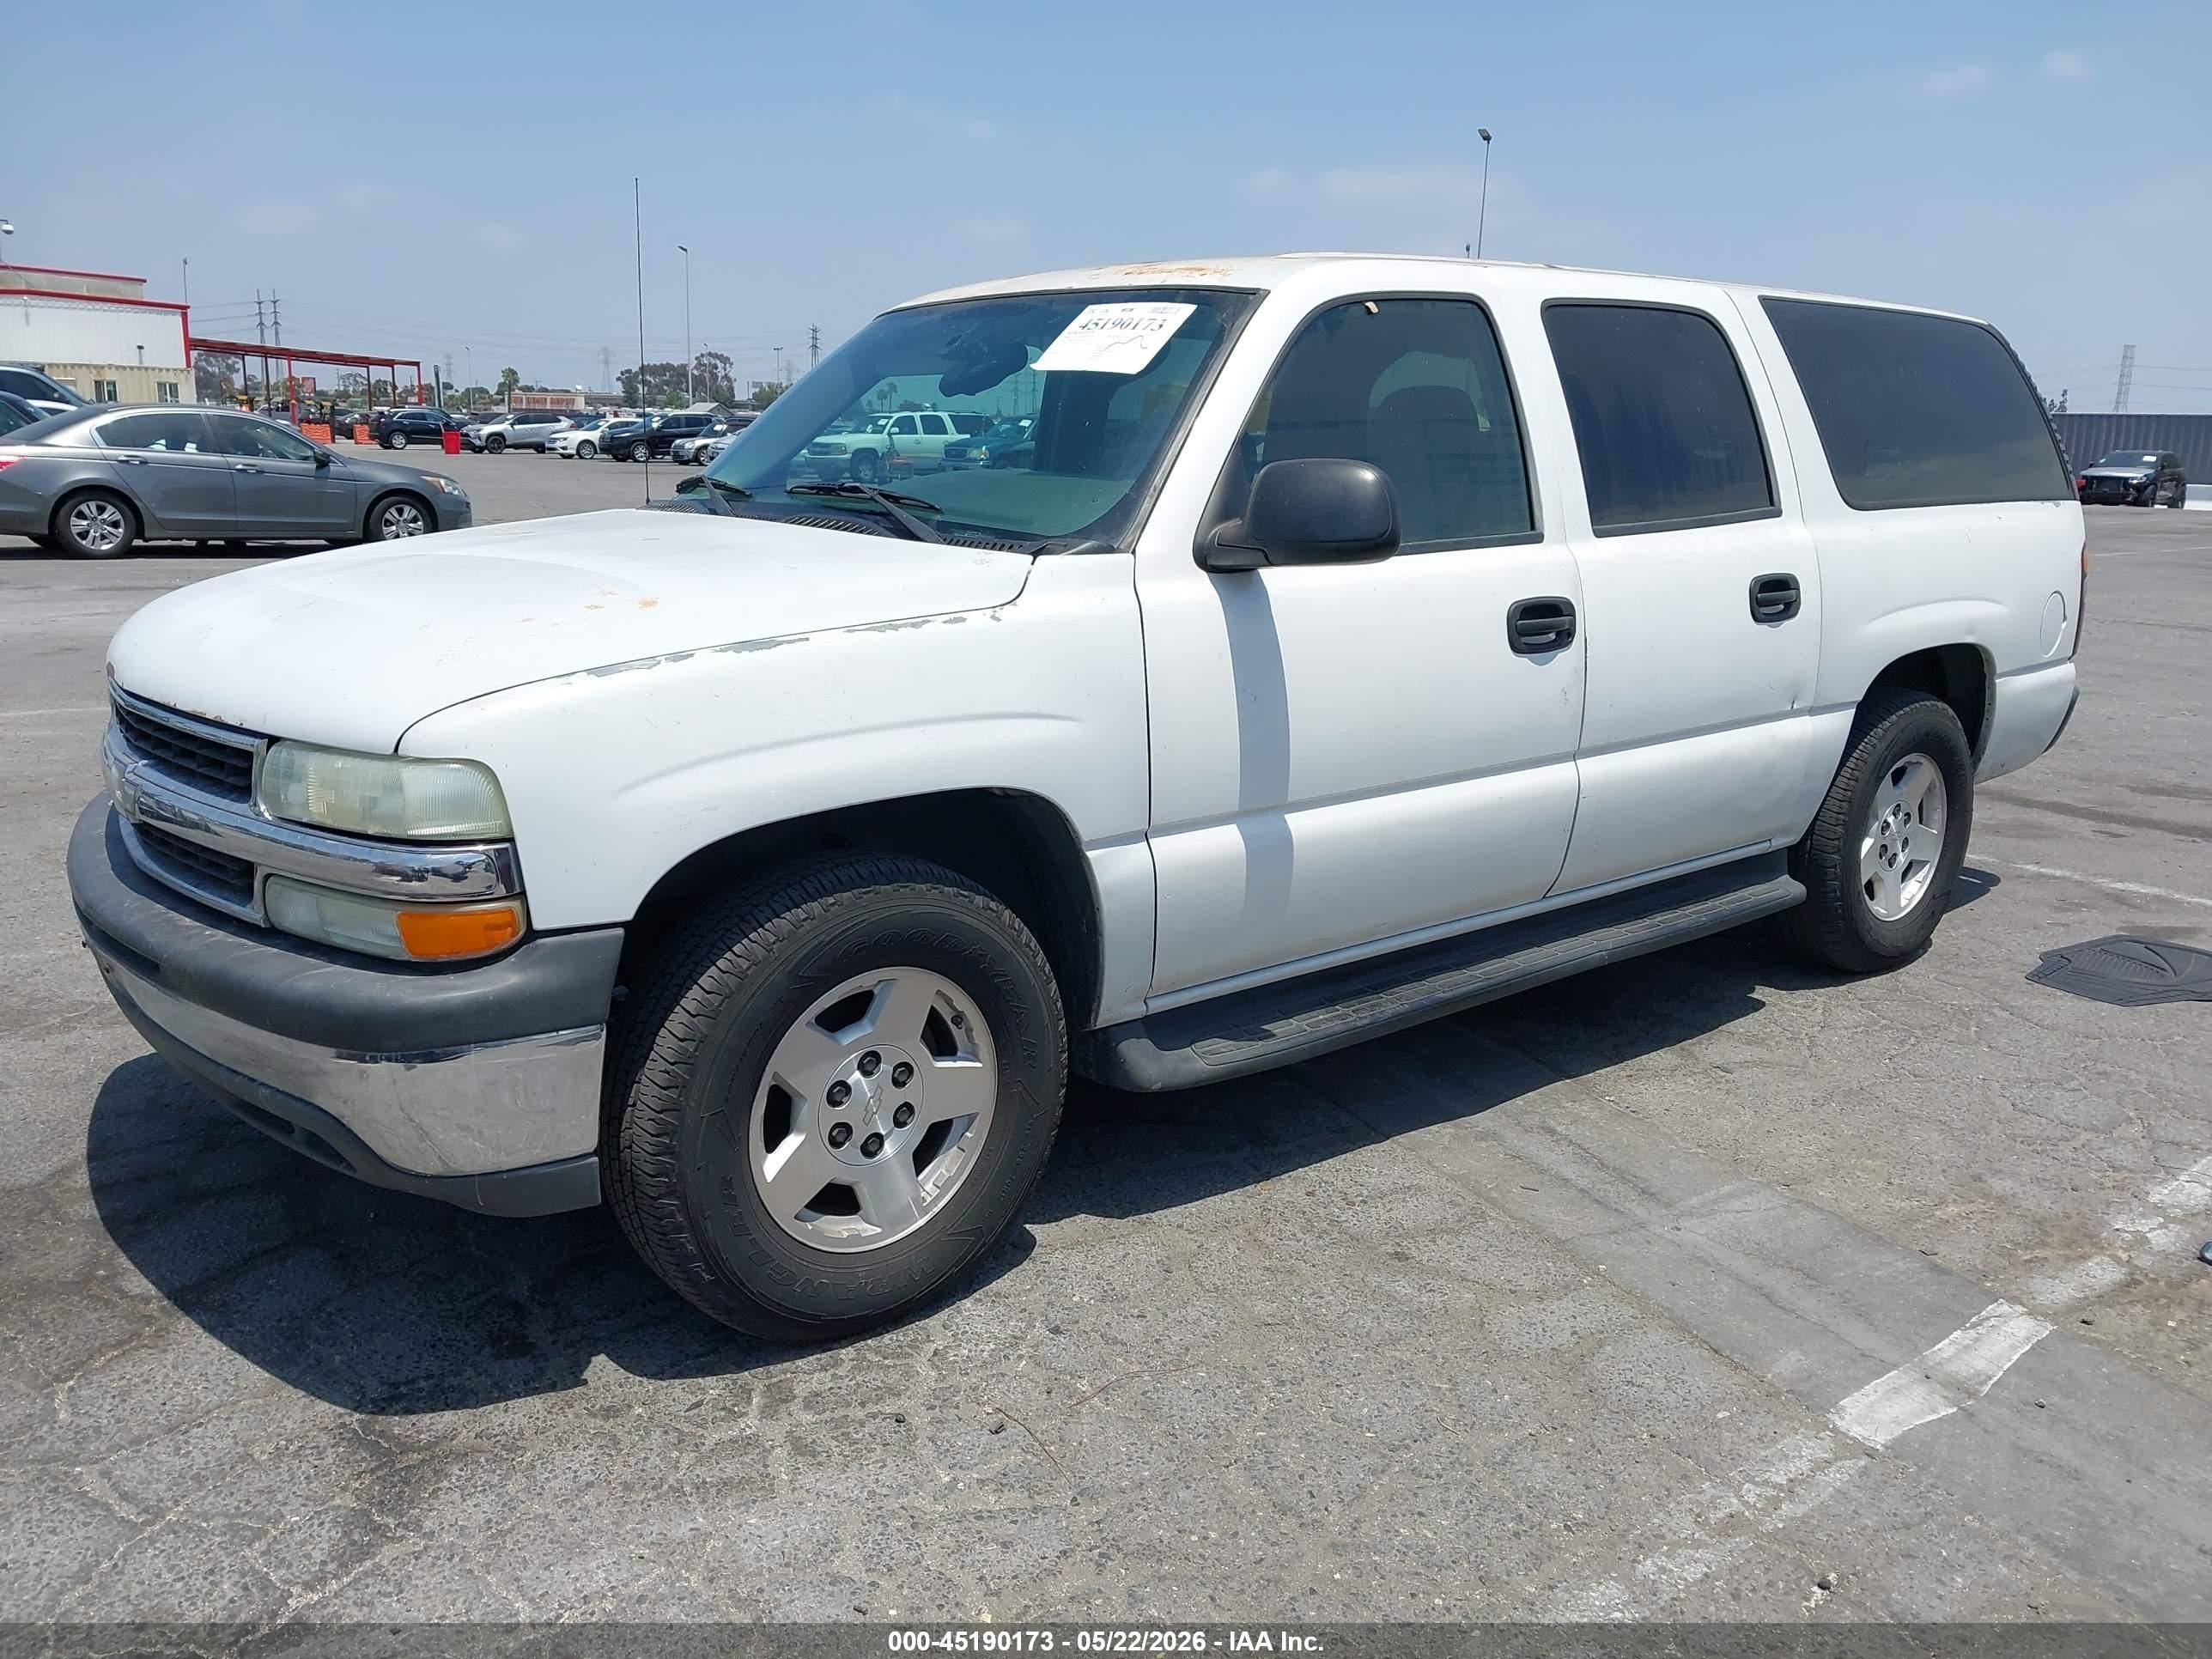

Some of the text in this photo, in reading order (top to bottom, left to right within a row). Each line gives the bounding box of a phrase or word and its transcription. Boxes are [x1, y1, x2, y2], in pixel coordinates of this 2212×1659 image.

[1079, 317, 1168, 332] 45190173
[836, 927, 1039, 1071] GOODYEAR
[719, 1174, 939, 1302] WRANGLER
